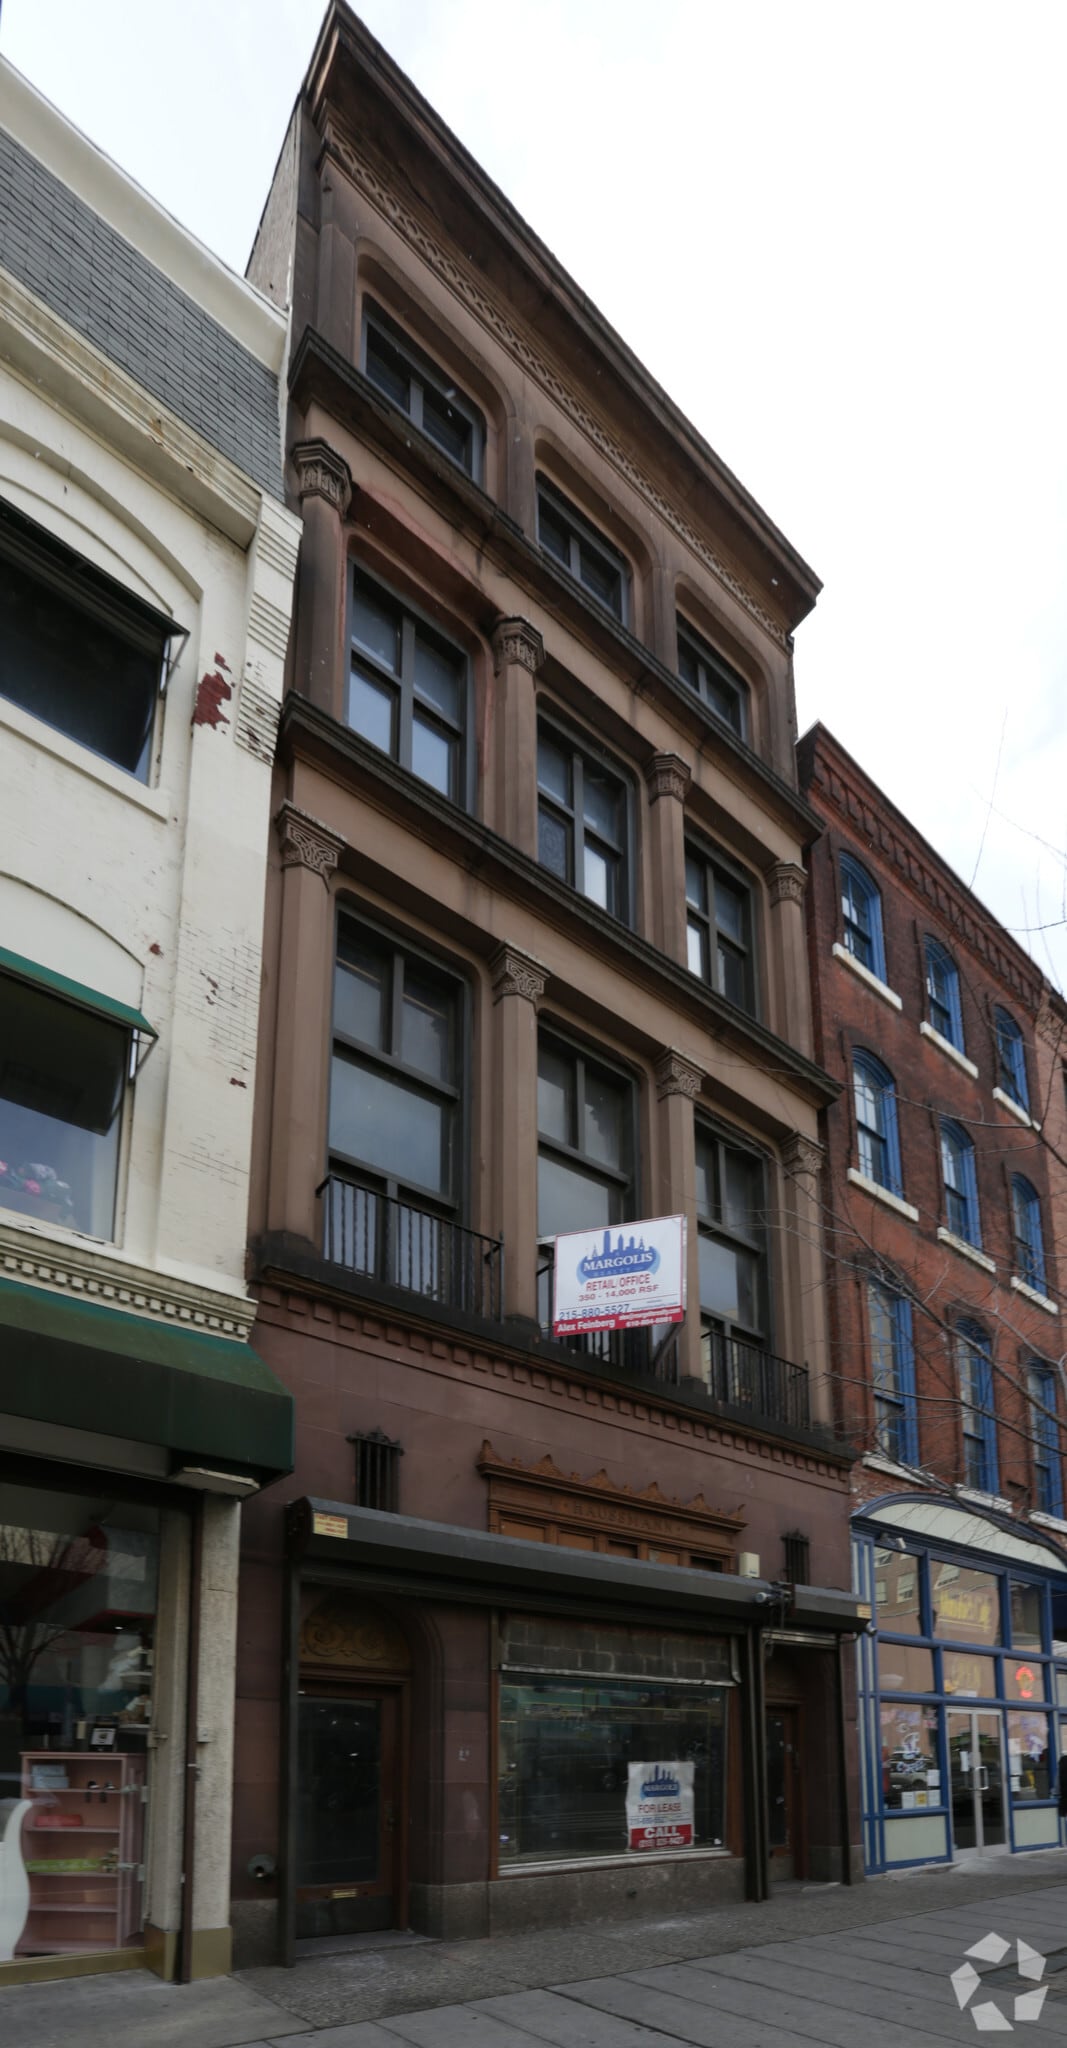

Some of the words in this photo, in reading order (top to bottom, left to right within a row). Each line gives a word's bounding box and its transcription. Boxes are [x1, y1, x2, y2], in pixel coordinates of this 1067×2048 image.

[583, 1252, 653, 1272] MARGOLIS
[578, 1293, 596, 1302] 350
[638, 1284, 659, 1294] RSF
[559, 1303, 630, 1321] 215-880-5527
[558, 1320, 576, 1332] Alex
[577, 1317, 616, 1330] Feinberg
[639, 1804, 656, 1813] FOR
[657, 1803, 682, 1812] LEASE
[644, 1827, 680, 1838] CALL
